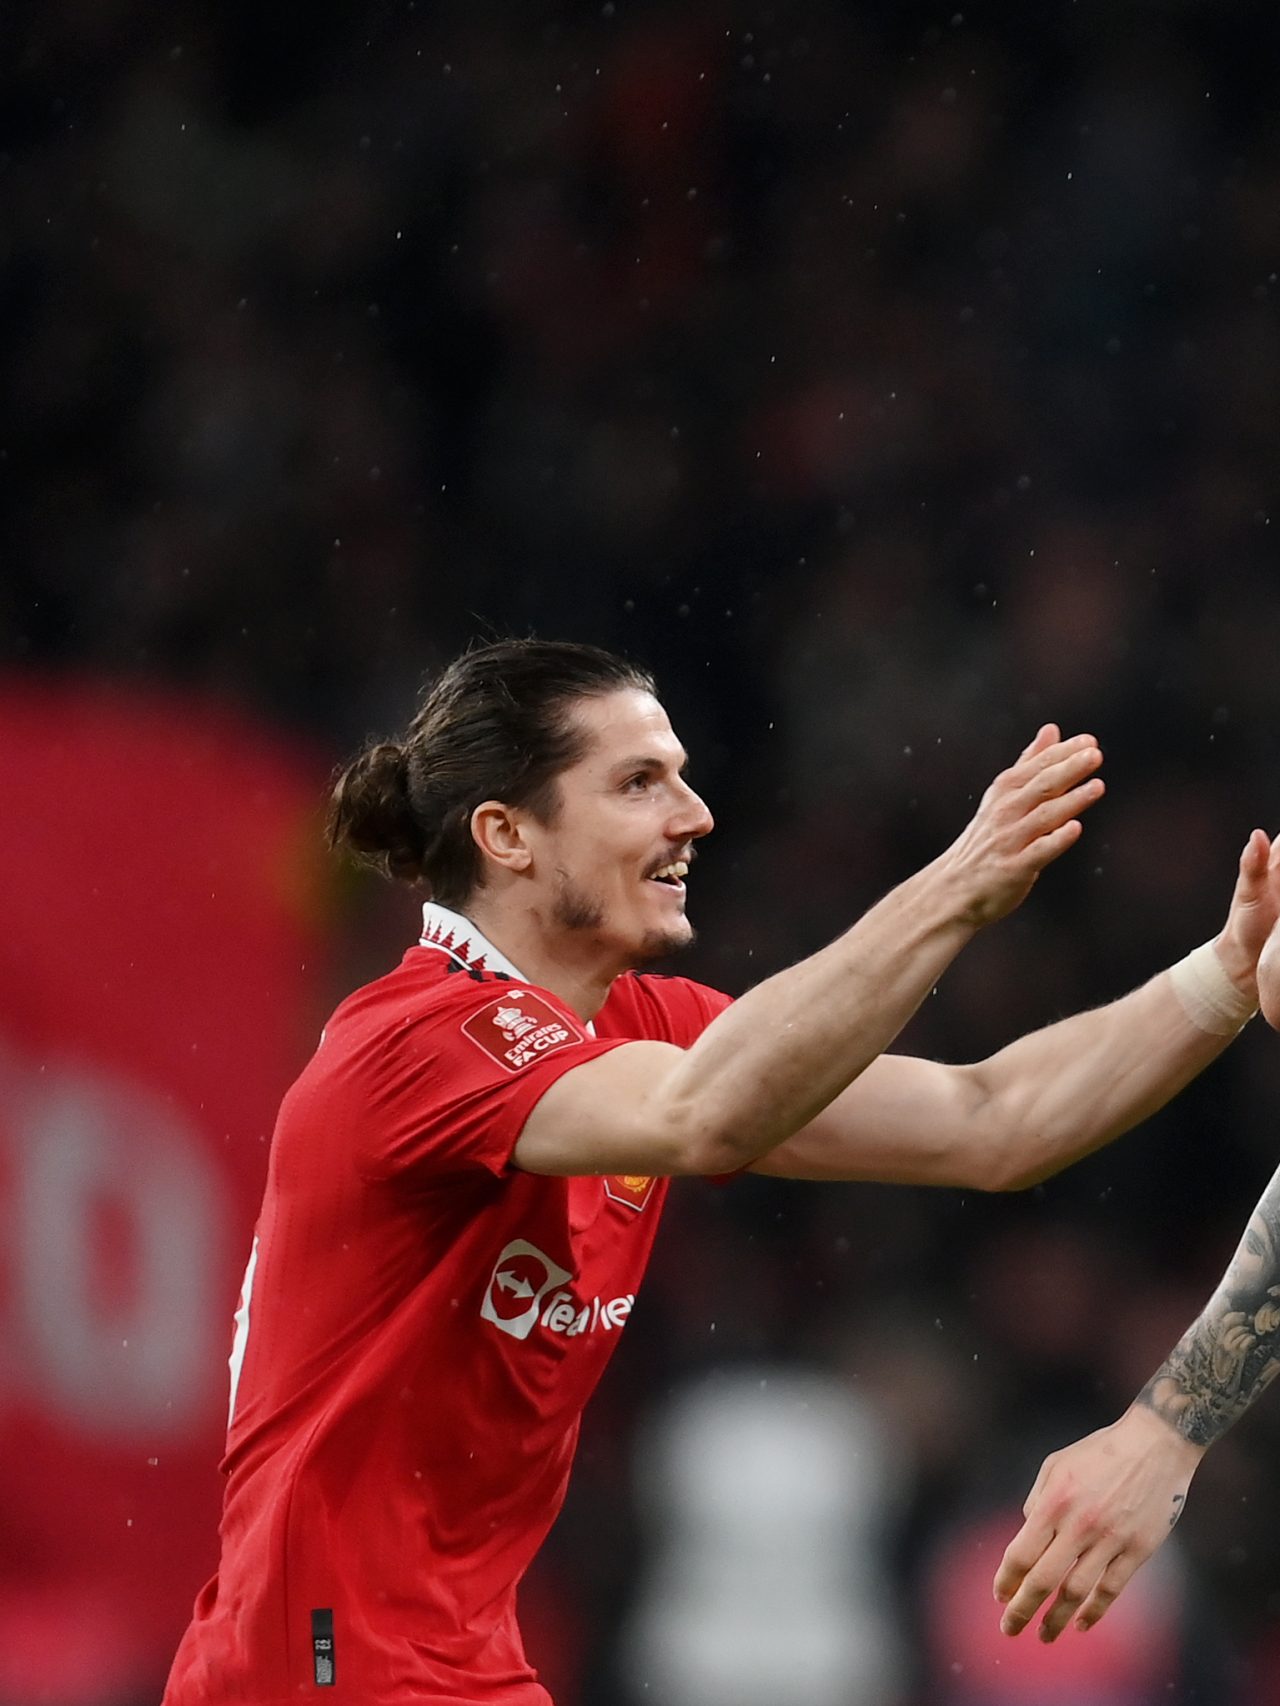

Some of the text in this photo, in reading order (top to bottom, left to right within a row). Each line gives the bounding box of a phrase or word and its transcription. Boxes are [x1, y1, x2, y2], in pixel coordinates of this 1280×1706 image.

[504, 1023, 562, 1061] Emirates
[512, 1030, 569, 1067] FA CUP
